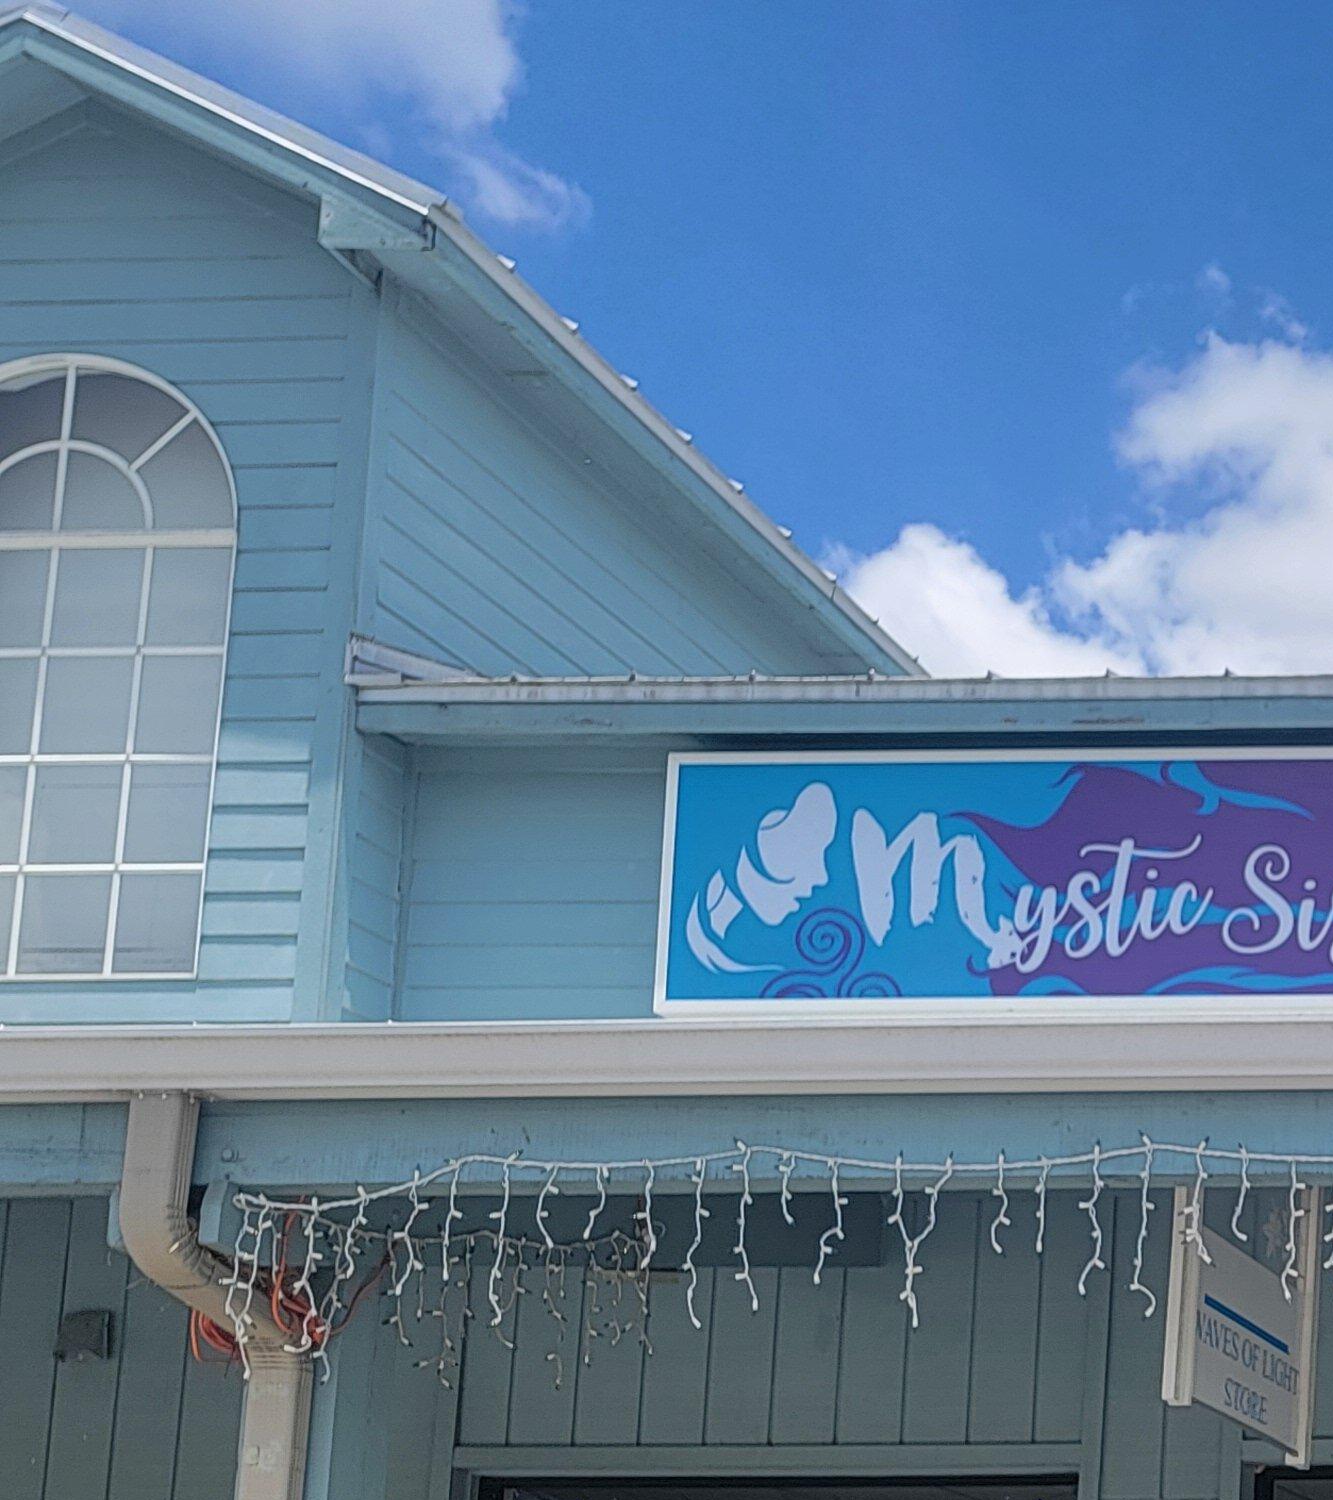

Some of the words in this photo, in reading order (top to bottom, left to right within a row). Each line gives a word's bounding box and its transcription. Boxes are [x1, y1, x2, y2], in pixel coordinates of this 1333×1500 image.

[852, 807, 1213, 974] Mystic
[1243, 1338, 1260, 1371] OF
[1262, 1348, 1300, 1395] LIGHT
[1223, 1377, 1268, 1425] STORE
